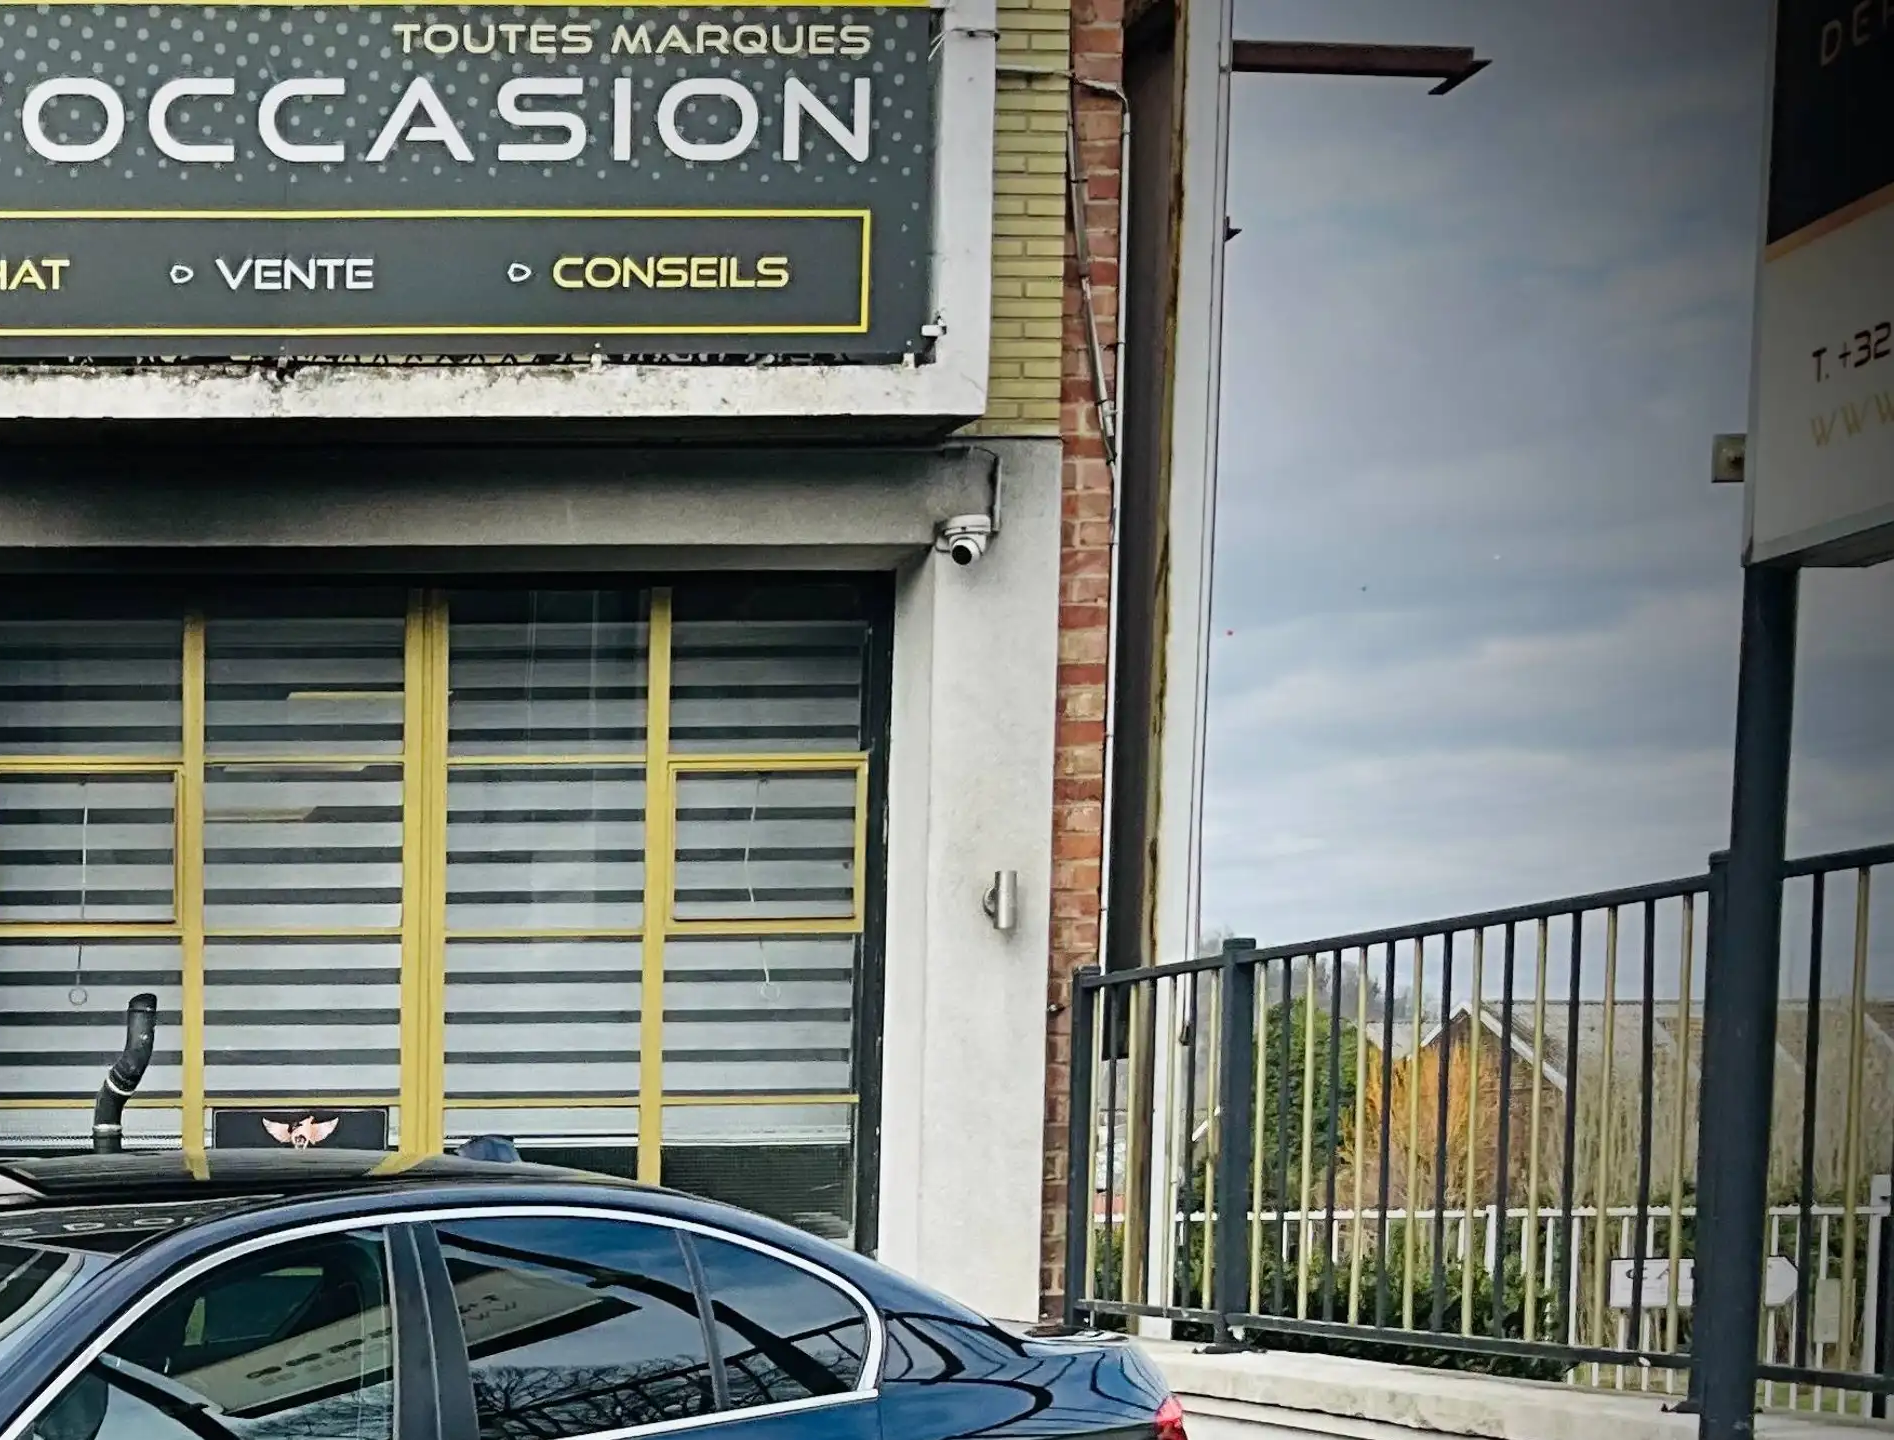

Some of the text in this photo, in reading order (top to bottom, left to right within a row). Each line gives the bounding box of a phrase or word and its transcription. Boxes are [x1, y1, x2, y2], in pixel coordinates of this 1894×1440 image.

[394, 24, 871, 54] TOUTES MARQUES
[216, 258, 374, 290] VENTE
[552, 257, 789, 288] CONSEILS
